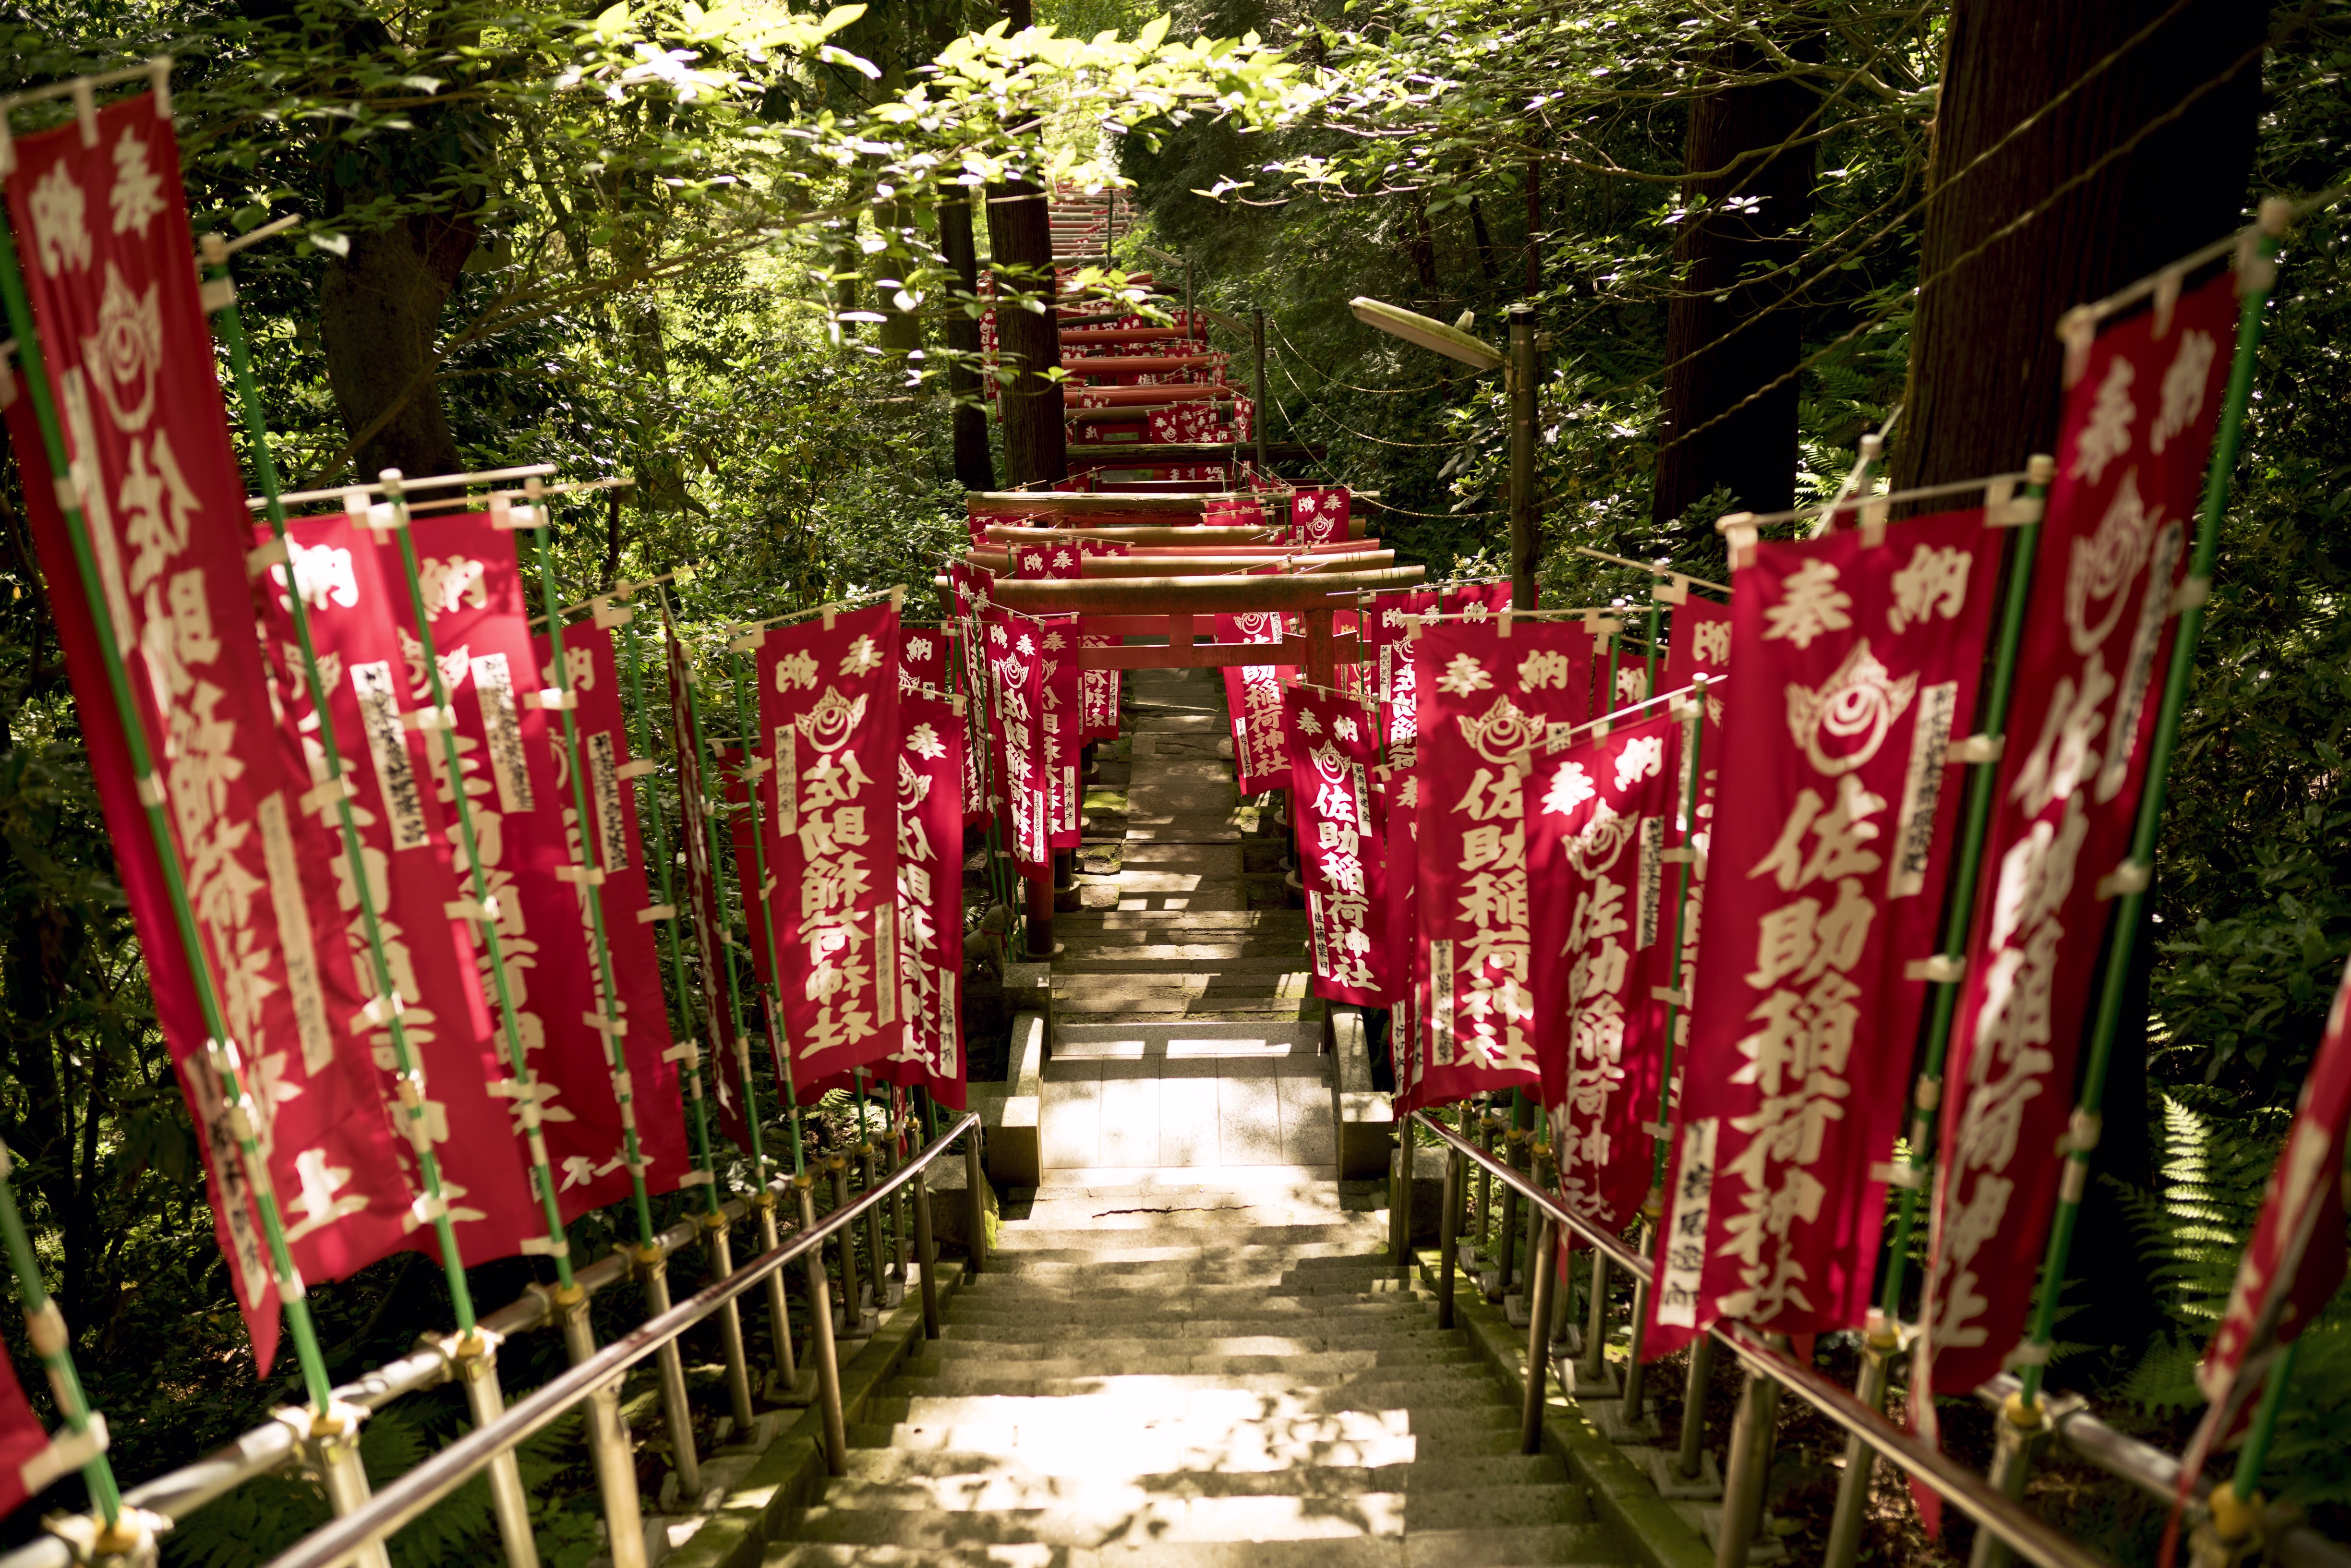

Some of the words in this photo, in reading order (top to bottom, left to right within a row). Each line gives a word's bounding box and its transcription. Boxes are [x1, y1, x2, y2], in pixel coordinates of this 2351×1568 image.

[1761, 543, 1973, 649] 奉納
[1436, 650, 1569, 698] 奉納
[1297, 707, 1358, 742] 奉納
[1540, 736, 1663, 816] 奉納
[1310, 783, 1382, 992] 佐助稲荷神社
